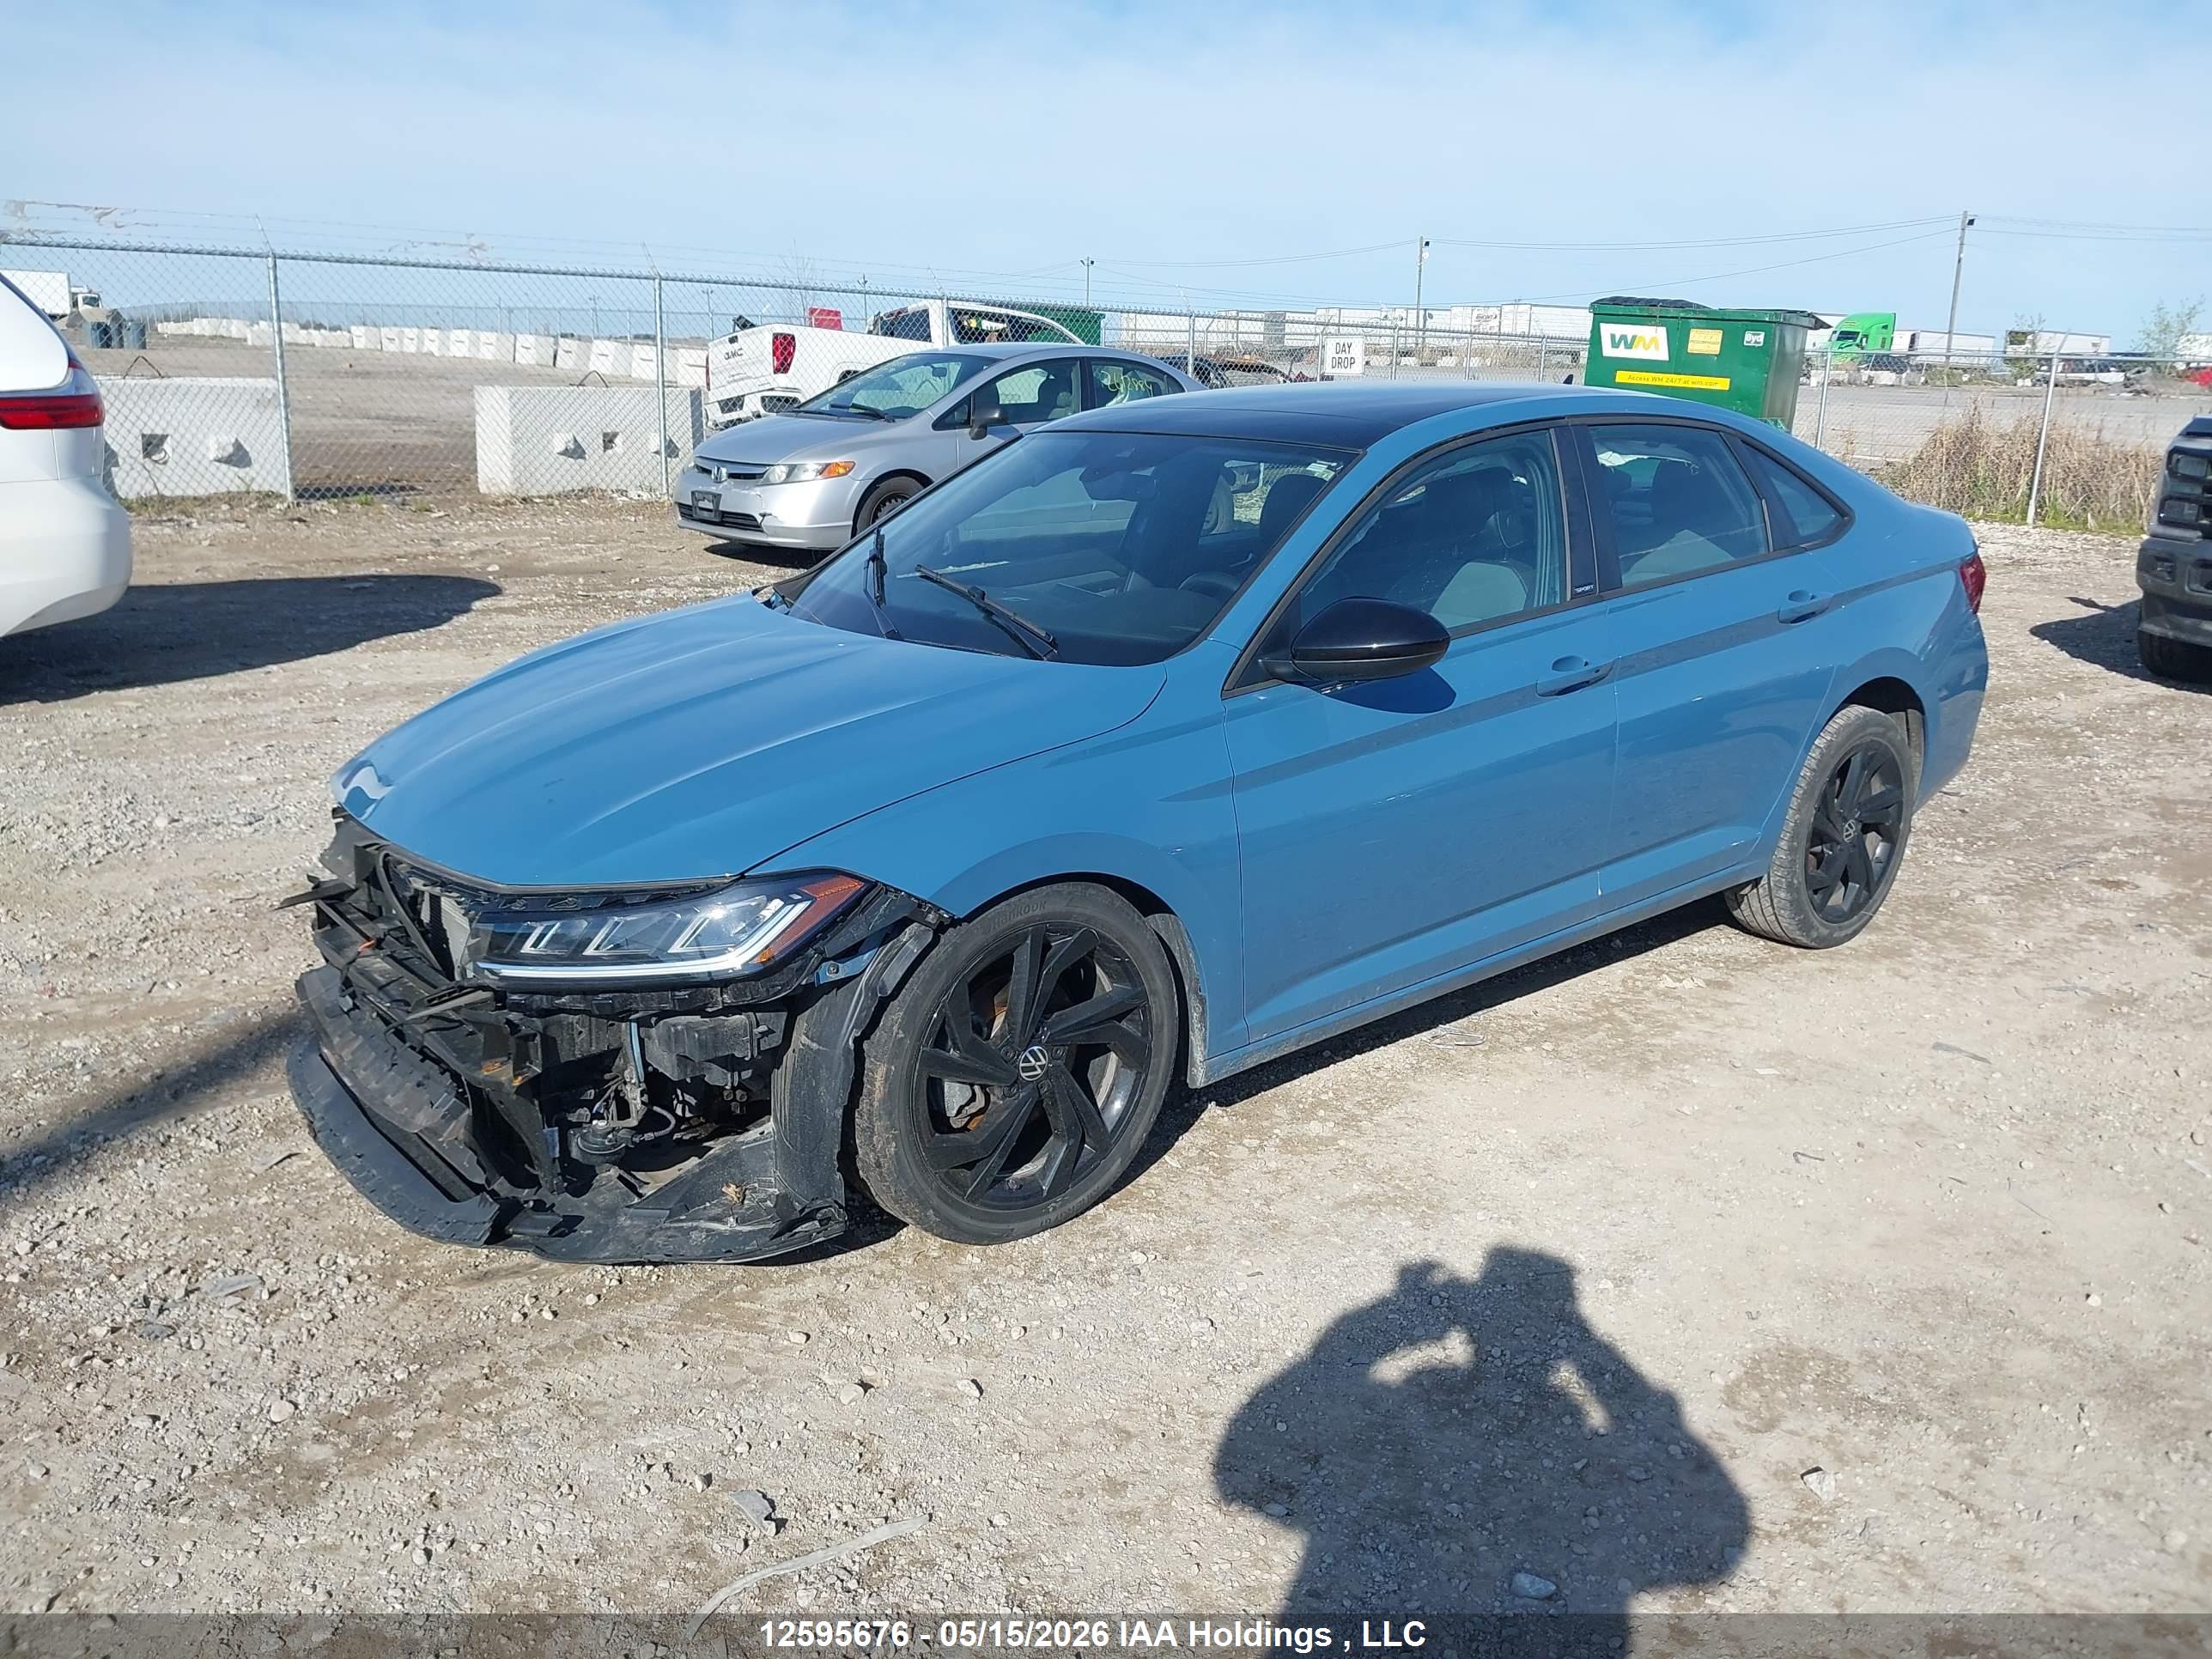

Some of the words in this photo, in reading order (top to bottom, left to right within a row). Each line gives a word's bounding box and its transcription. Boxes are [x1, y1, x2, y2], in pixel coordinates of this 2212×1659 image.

[1335, 342, 1352, 355] DAY
[1610, 332, 1659, 352] WM
[1331, 356, 1356, 369] DROP
